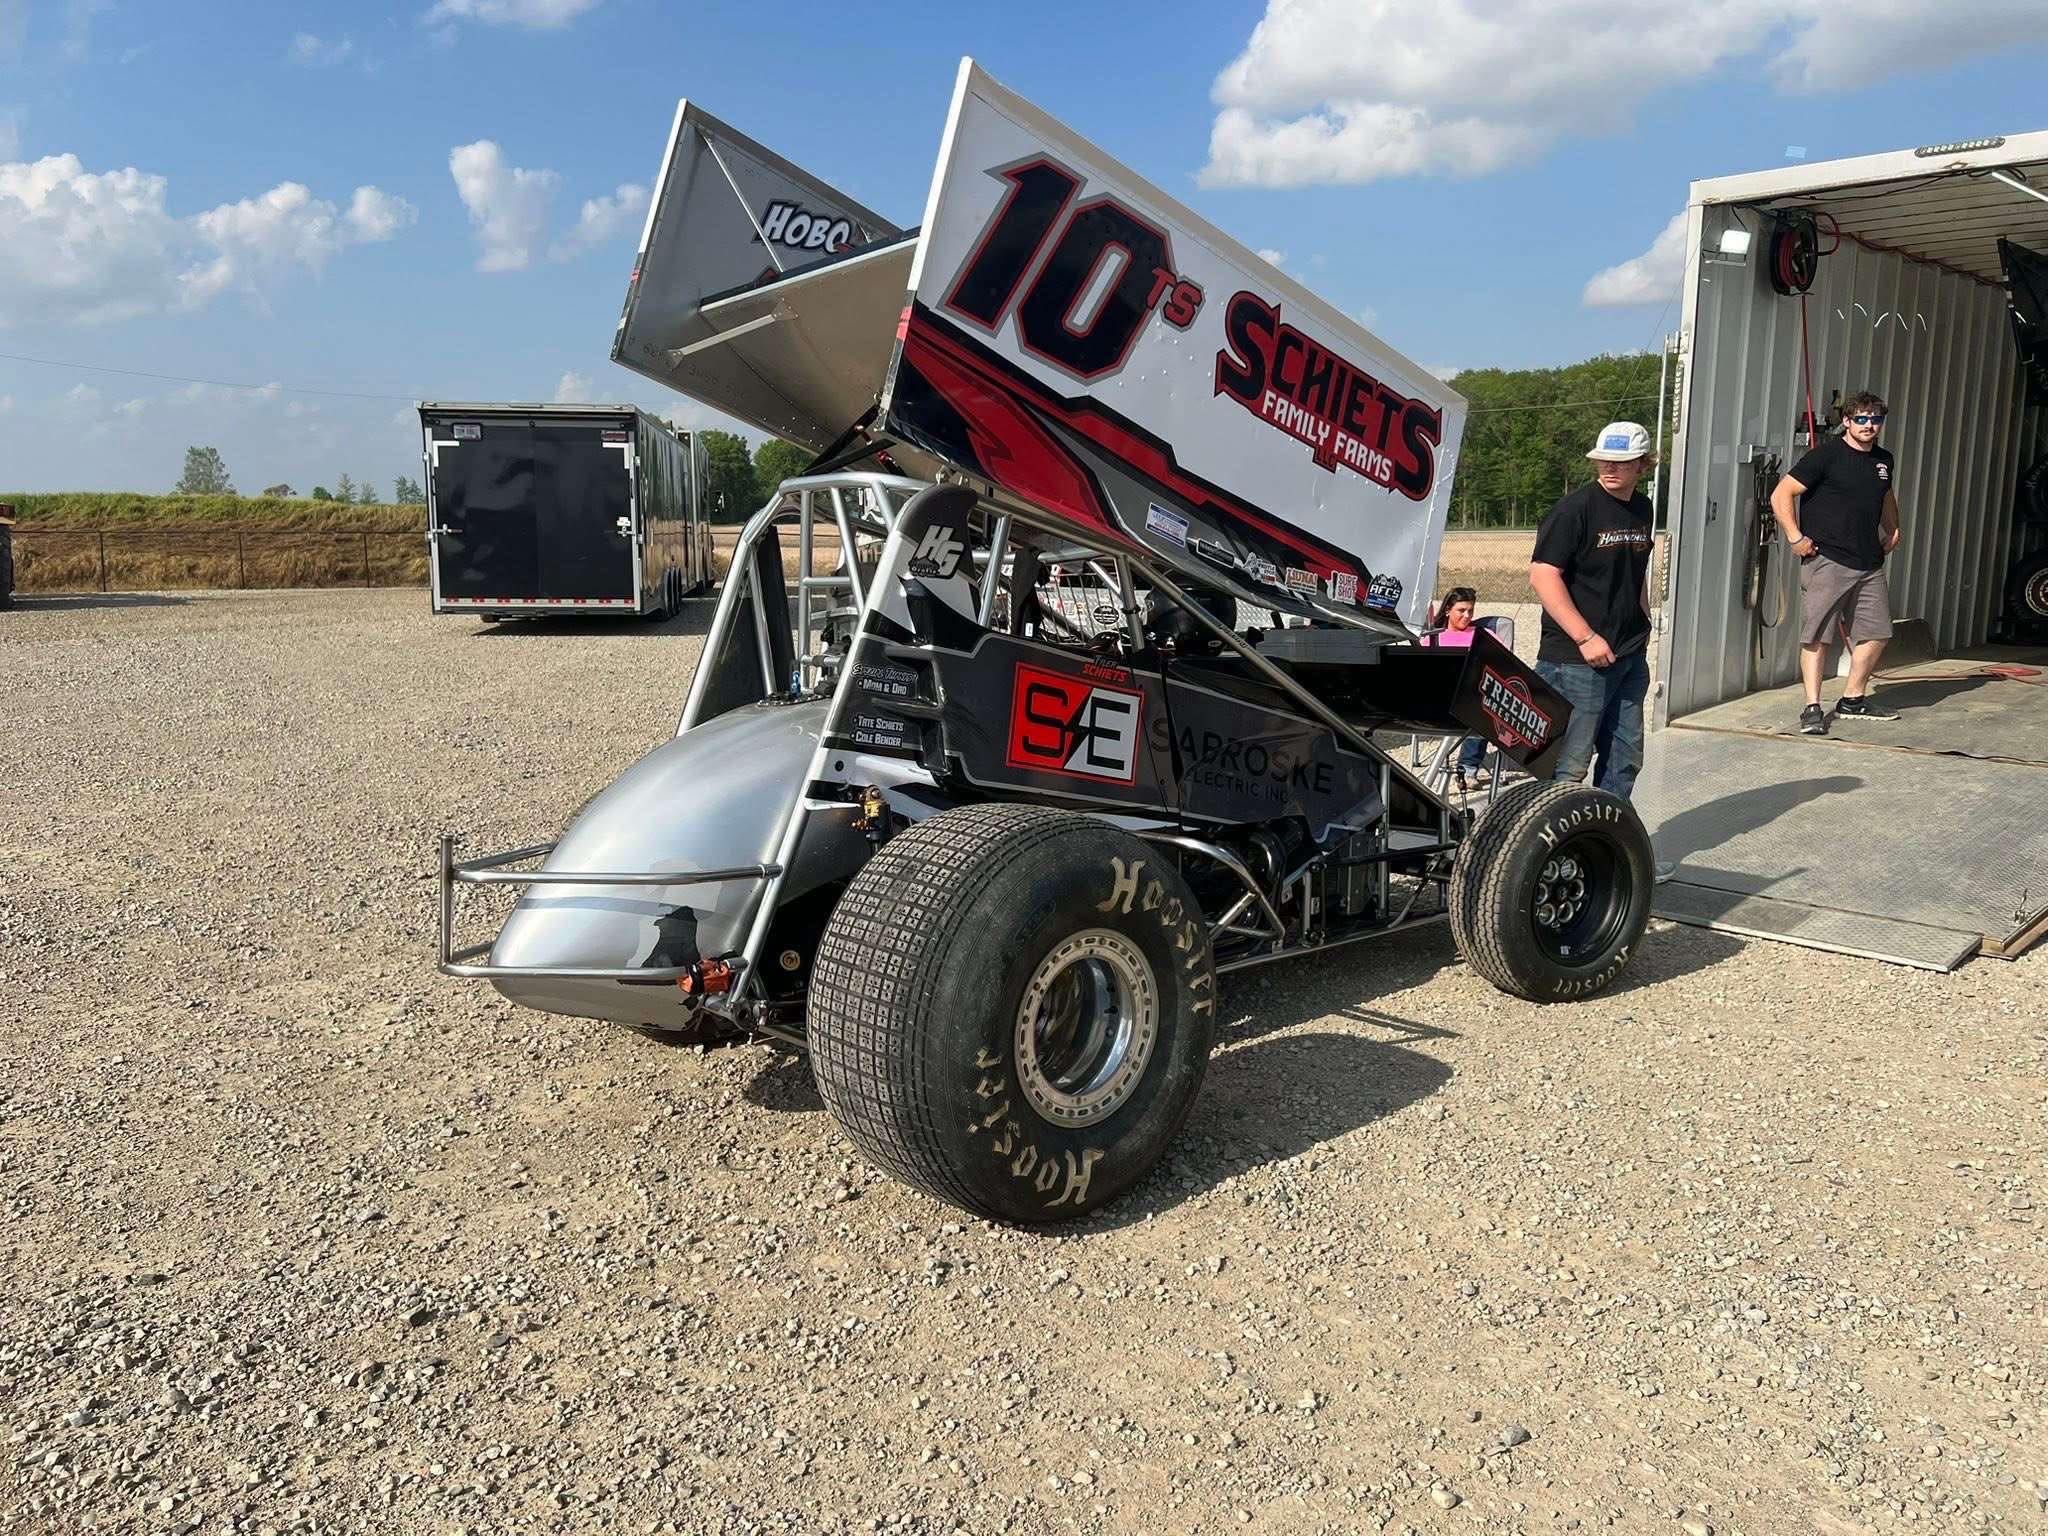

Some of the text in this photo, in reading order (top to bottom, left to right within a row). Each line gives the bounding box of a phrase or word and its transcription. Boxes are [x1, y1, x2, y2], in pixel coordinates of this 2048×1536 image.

[760, 203, 851, 254] HOBO
[940, 154, 1176, 382] 10
[1216, 292, 1441, 500] SCHIETS
[1262, 390, 1393, 483] FAMILY FARMS
[1370, 584, 1400, 599] AFCS
[1083, 662, 1128, 683] SCHIETS
[876, 718, 904, 731] SCHIETS
[1481, 670, 1548, 738] FREEDOM
[1482, 695, 1539, 746] WRESTLING
[856, 731, 901, 747] COLE BENDER
[1150, 717, 1335, 795] SABROSKE
